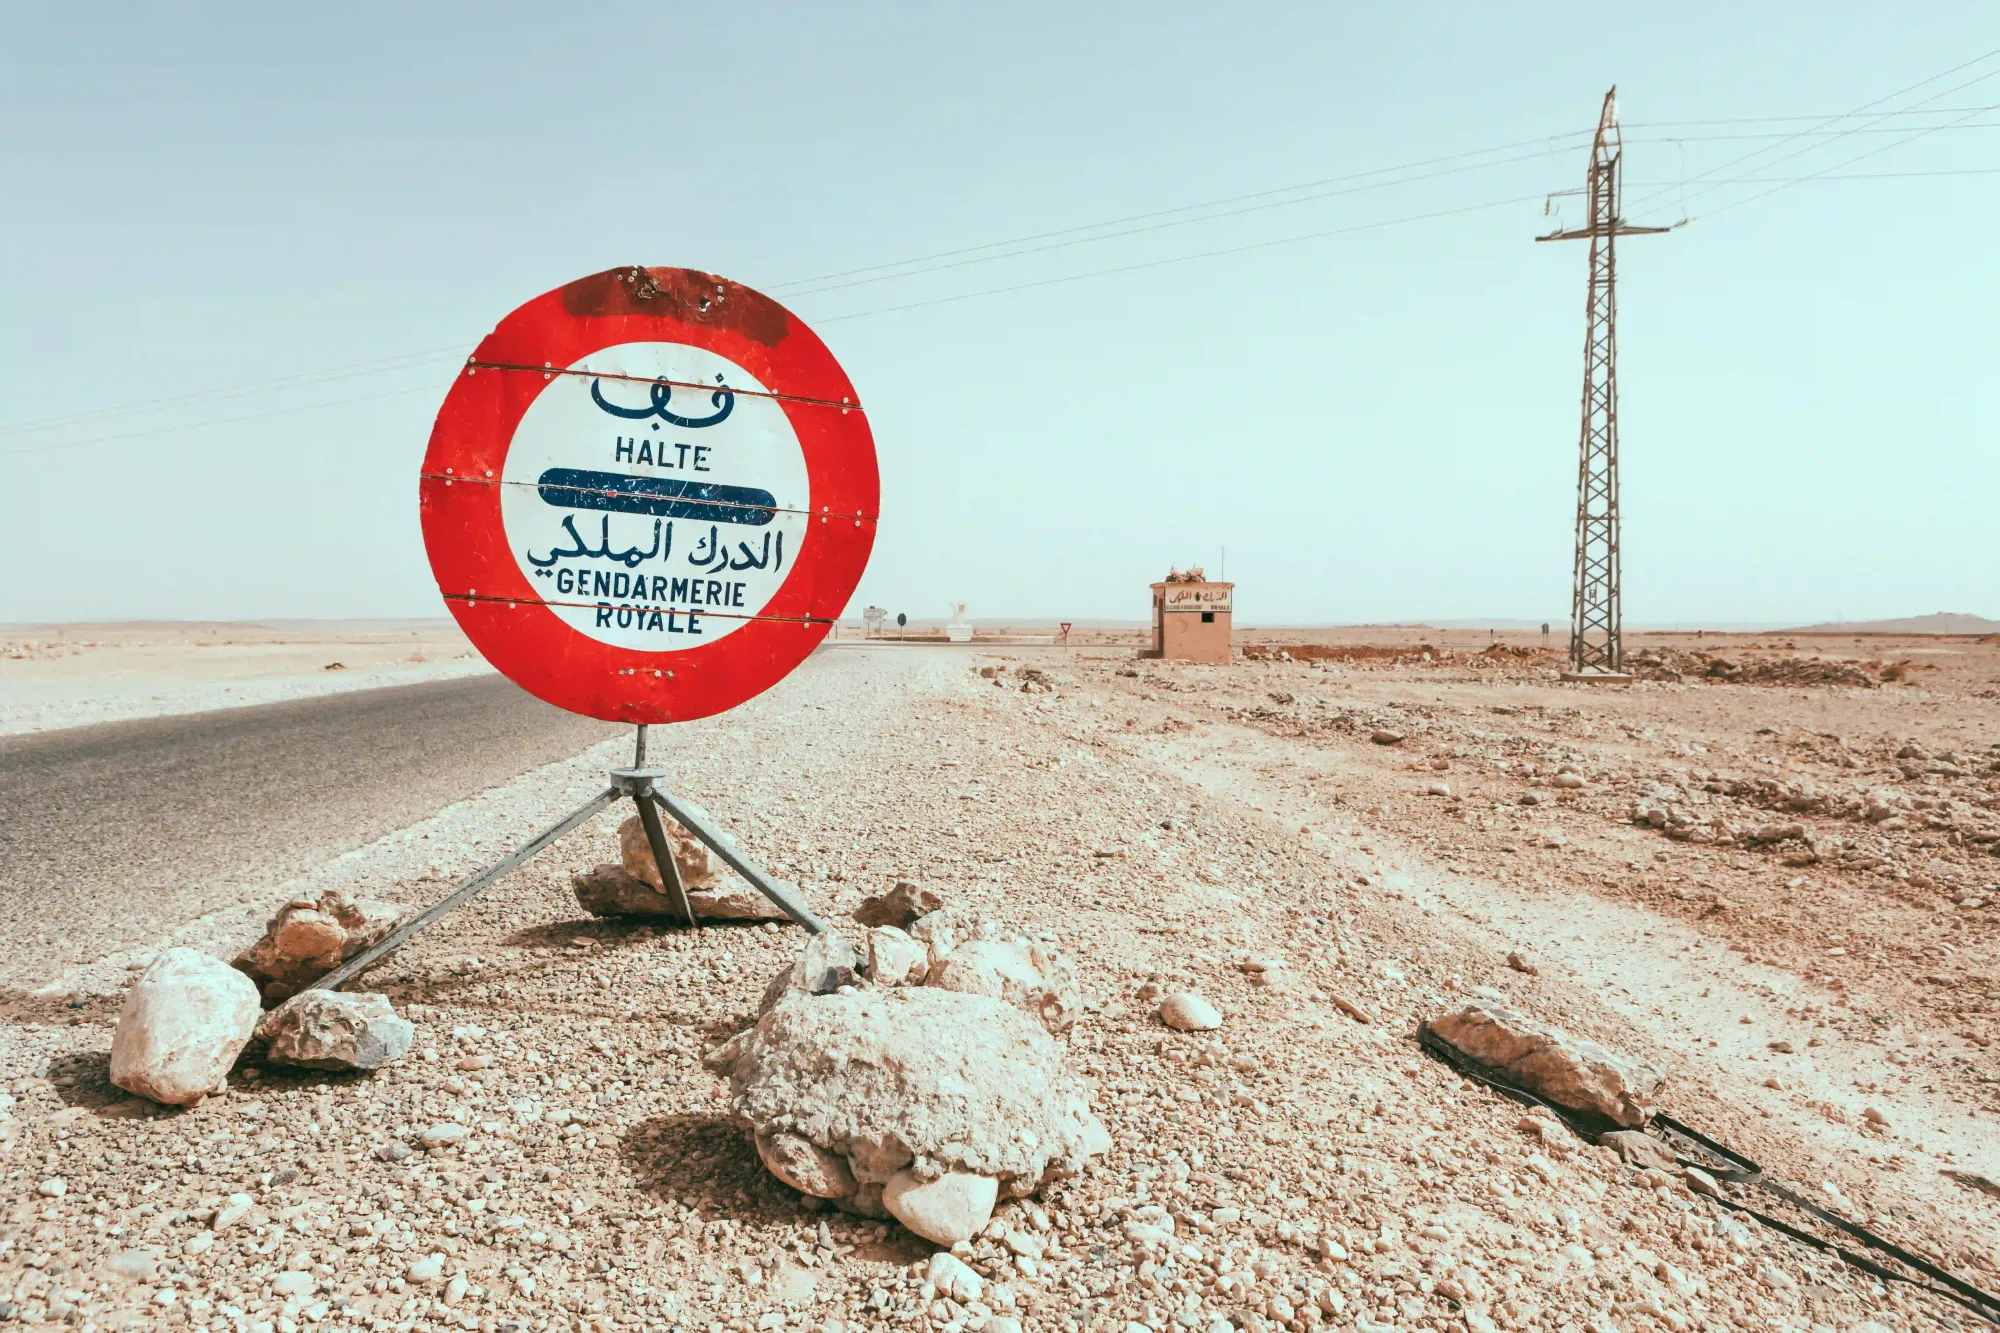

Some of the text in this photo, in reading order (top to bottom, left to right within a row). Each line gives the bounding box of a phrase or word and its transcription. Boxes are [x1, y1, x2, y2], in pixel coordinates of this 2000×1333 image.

[615, 436, 712, 472] HALTE
[527, 514, 783, 578] الدرك الملكي
[556, 568, 746, 607] GENDARMERIE
[596, 602, 705, 634] ROYALE
